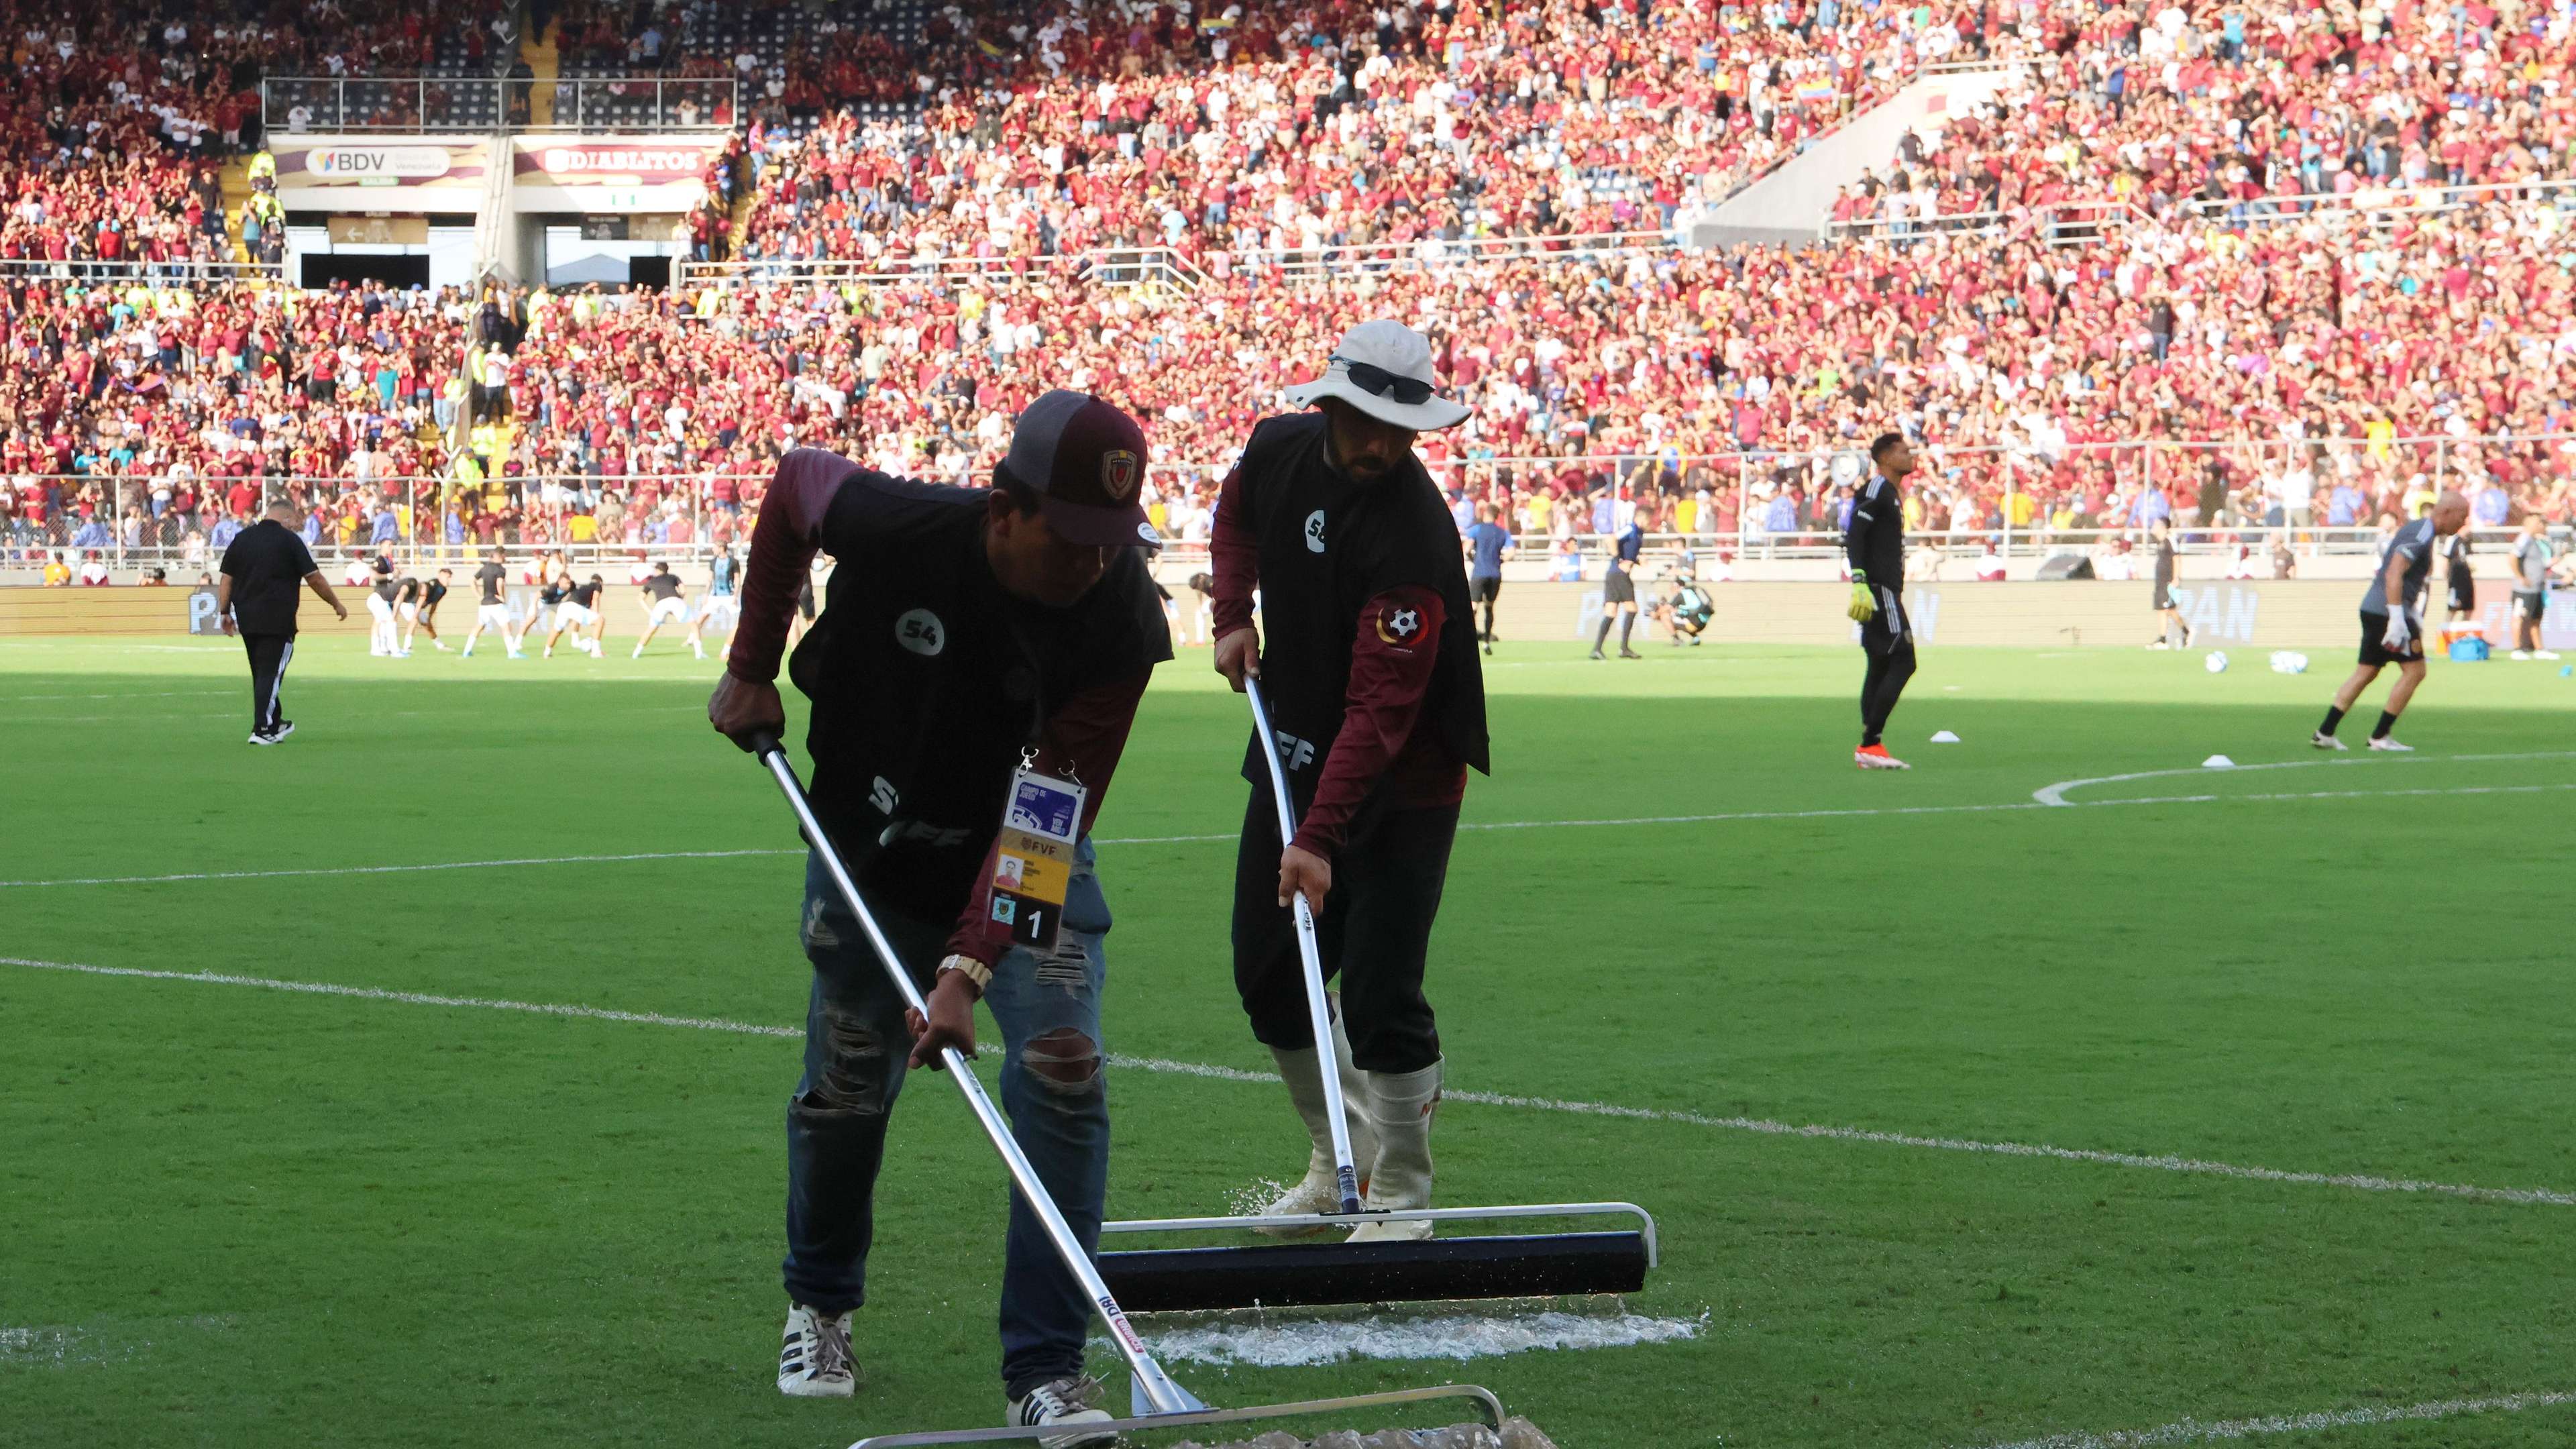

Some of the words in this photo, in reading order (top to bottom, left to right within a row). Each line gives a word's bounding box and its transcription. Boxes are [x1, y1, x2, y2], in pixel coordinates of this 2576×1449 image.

[338, 154, 384, 170] BDV
[570, 151, 700, 170] DIABLITOS
[903, 621, 937, 646] 54
[1032, 841, 1057, 855] FVF
[1028, 910, 1042, 938] 1
[1098, 1296, 1120, 1317] DRI
